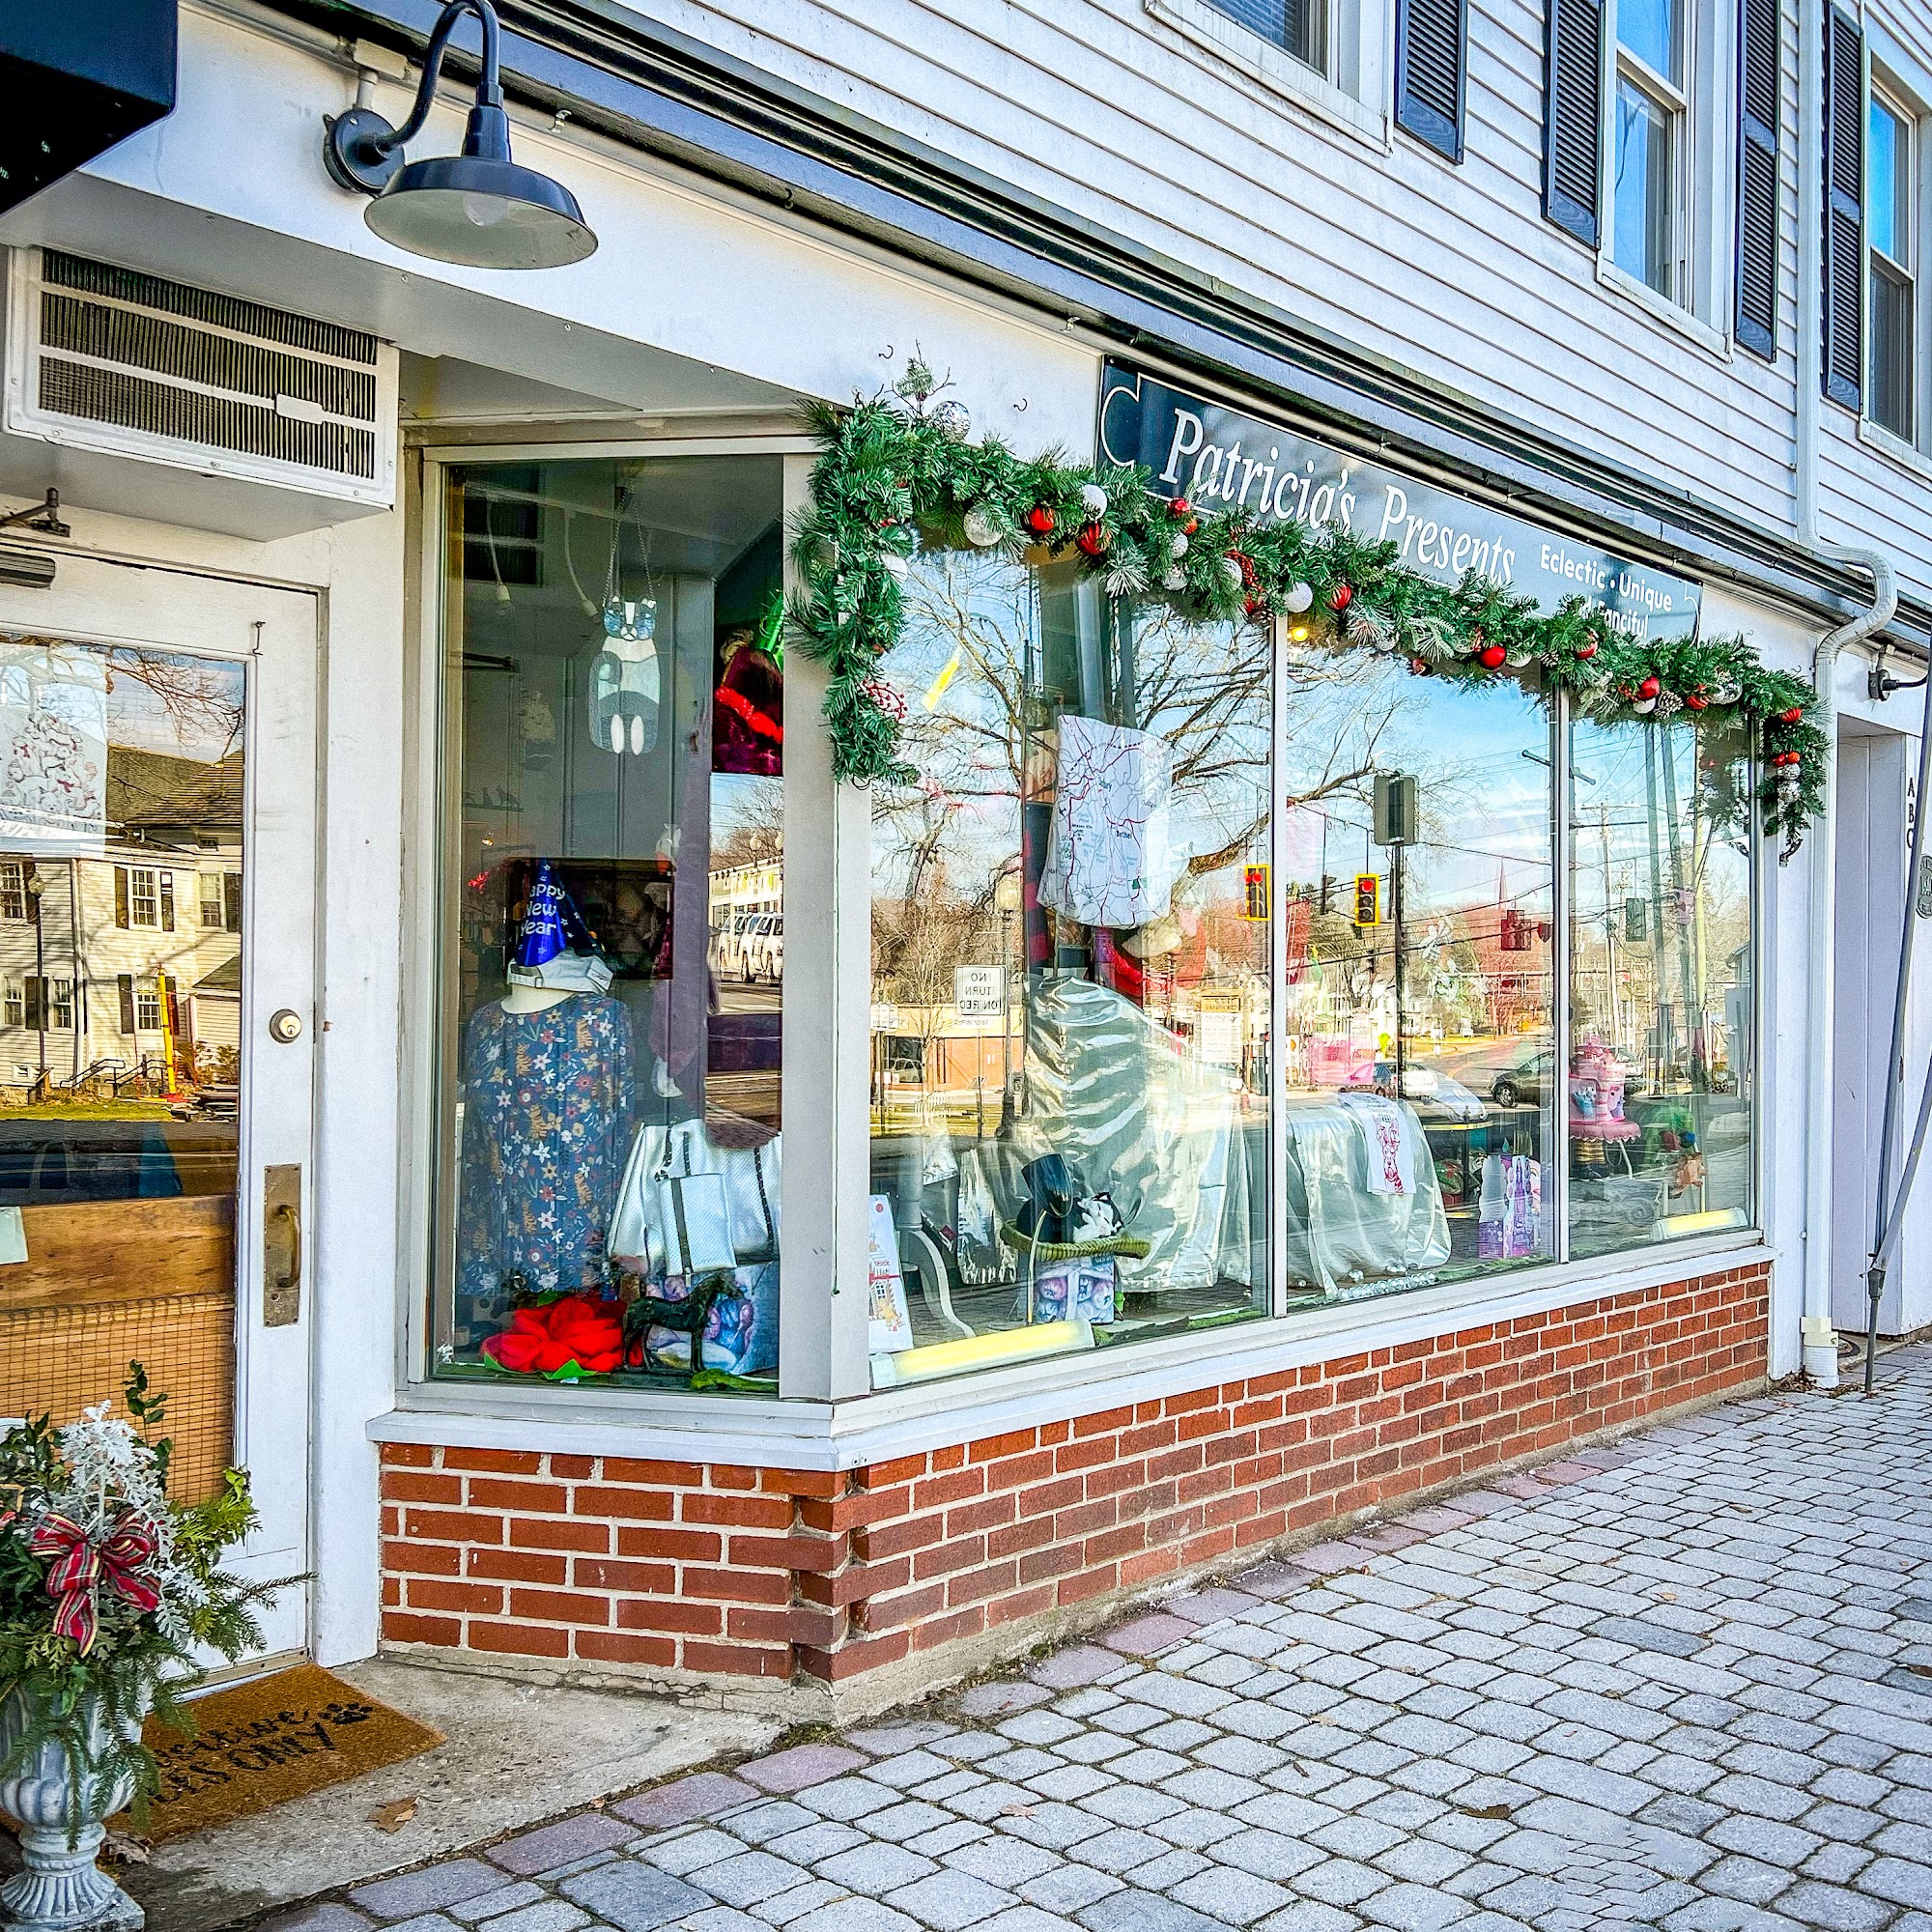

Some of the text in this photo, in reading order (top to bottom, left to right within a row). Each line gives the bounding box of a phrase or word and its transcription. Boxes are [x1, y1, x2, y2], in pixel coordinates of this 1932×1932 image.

[1159, 408, 1516, 584] Patricia's Presents
[1540, 544, 1606, 589] Eclectic
[1619, 572, 1672, 612] Unique
